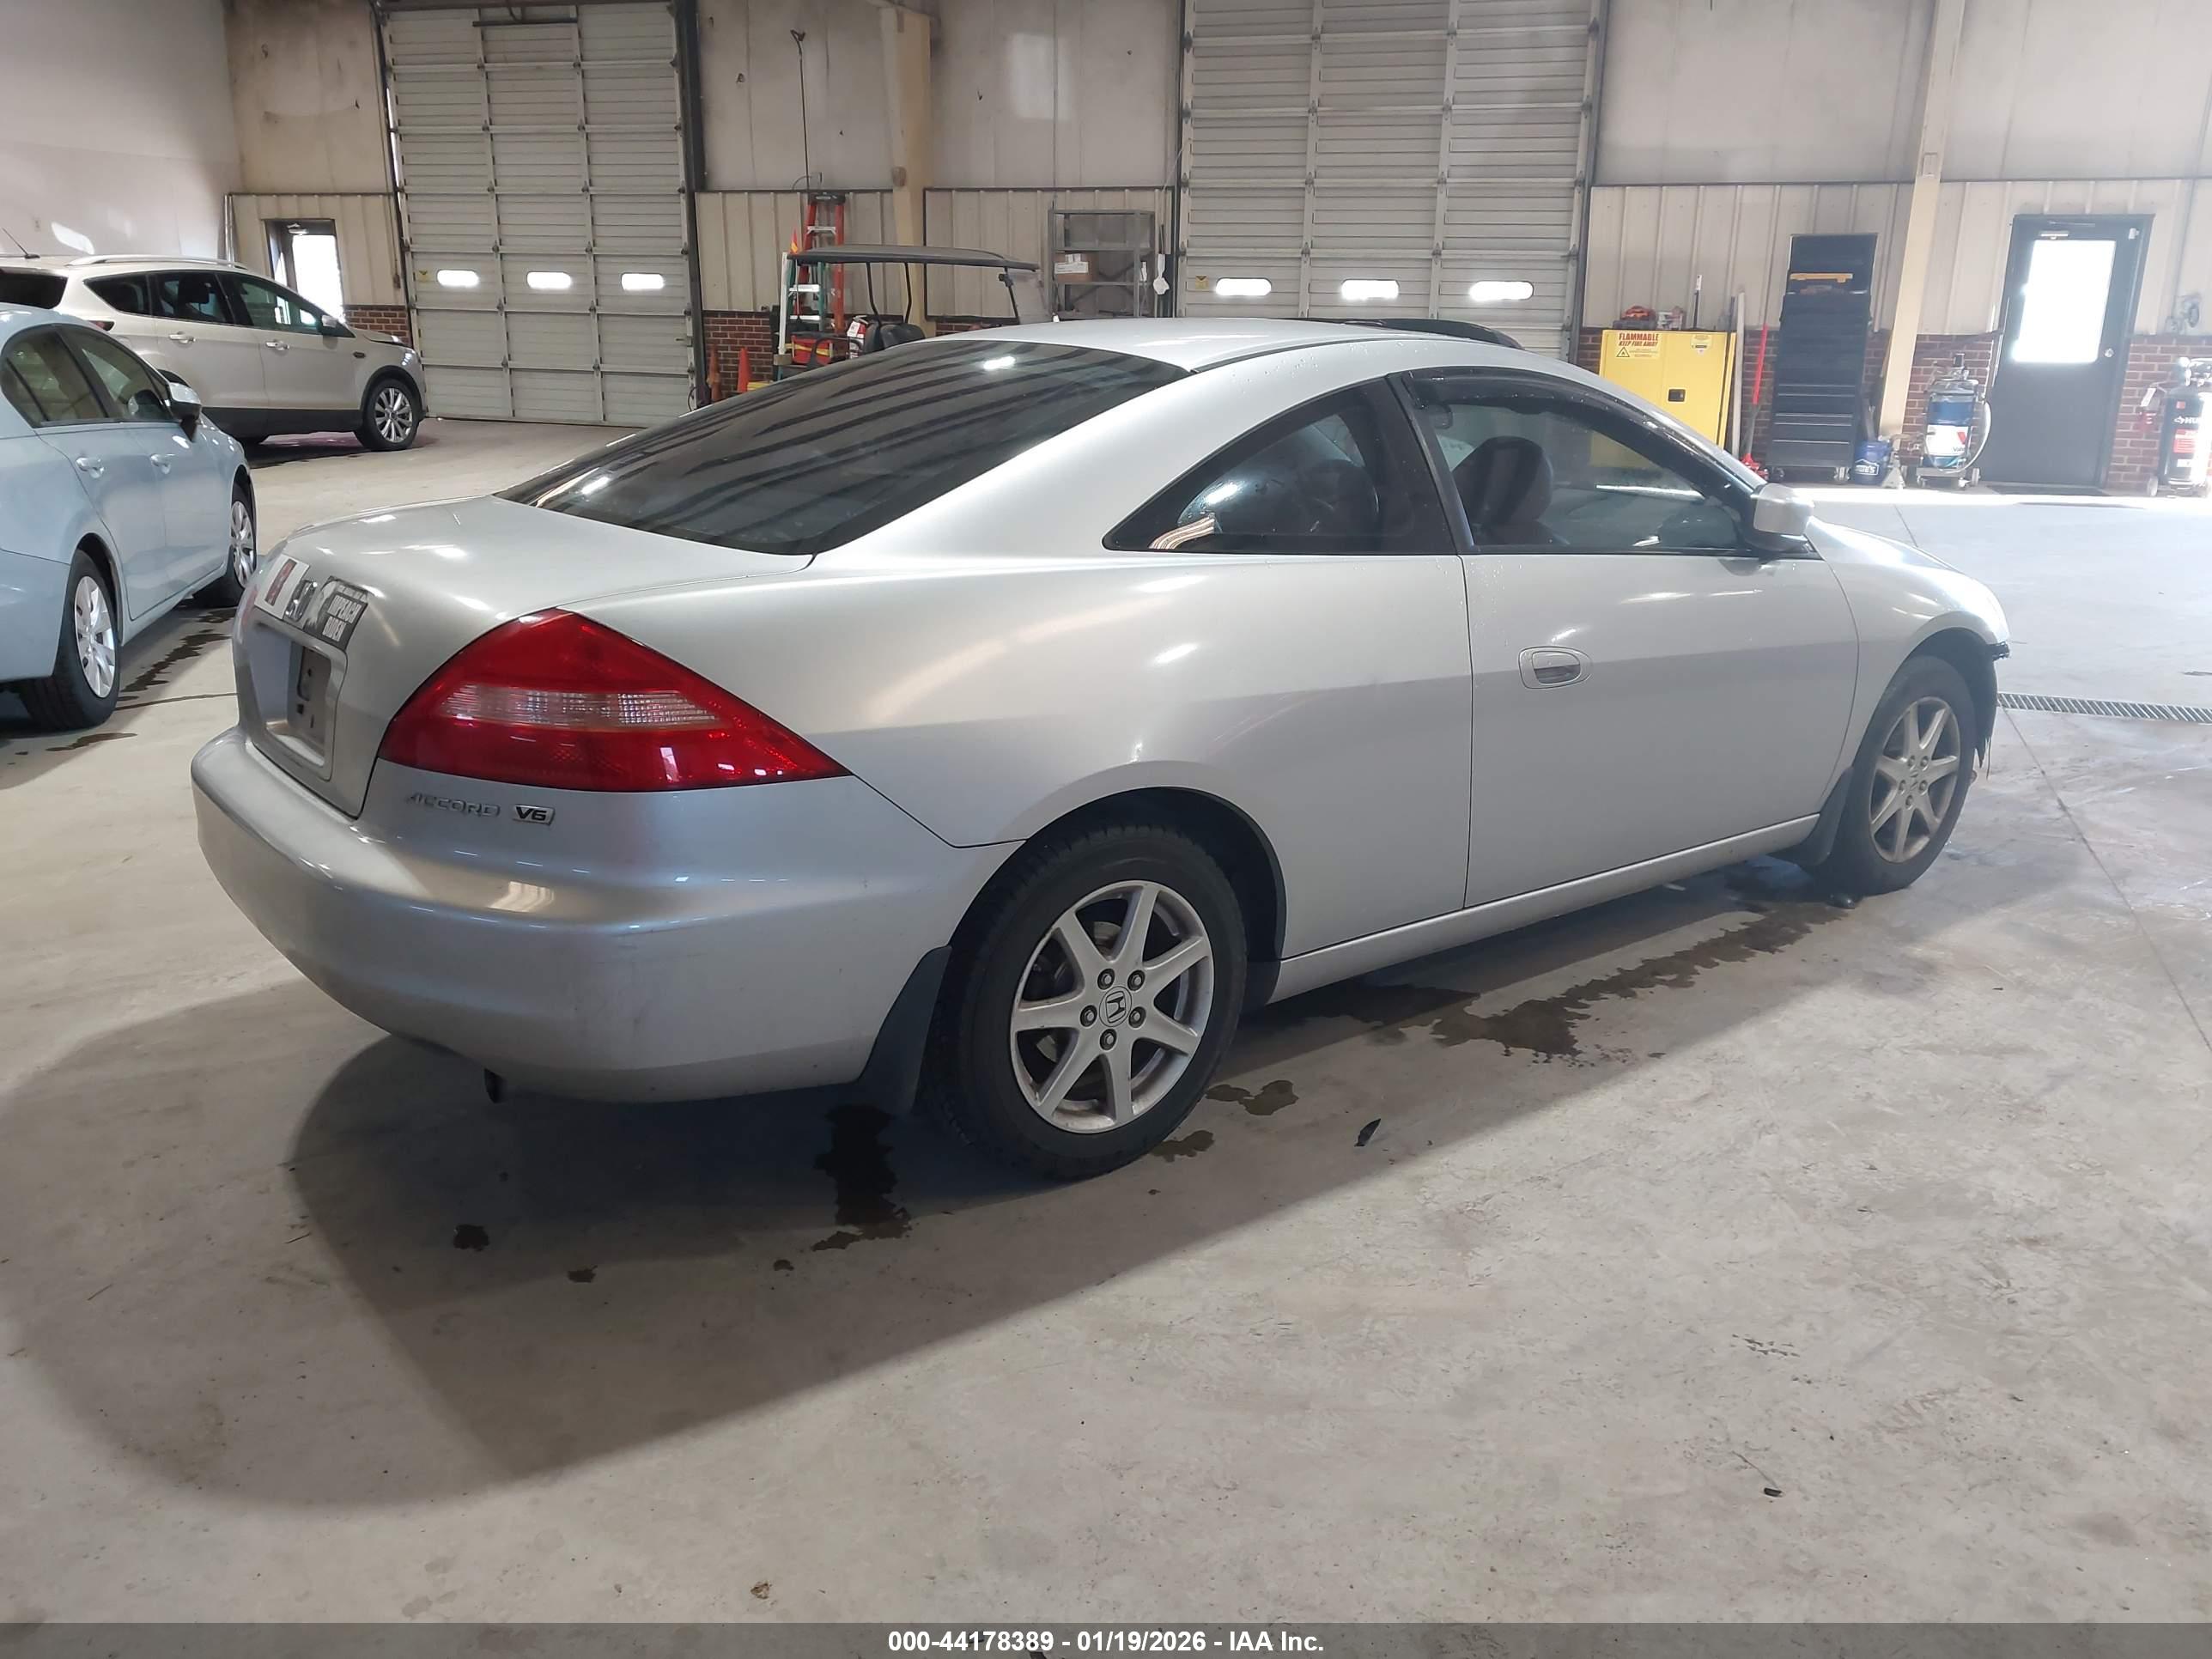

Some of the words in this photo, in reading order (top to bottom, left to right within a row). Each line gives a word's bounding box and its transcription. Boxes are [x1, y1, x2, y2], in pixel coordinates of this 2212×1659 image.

[1619, 332, 1659, 341] FLAMMABLE
[405, 792, 501, 817] ACCORD
[515, 805, 548, 822] V6
